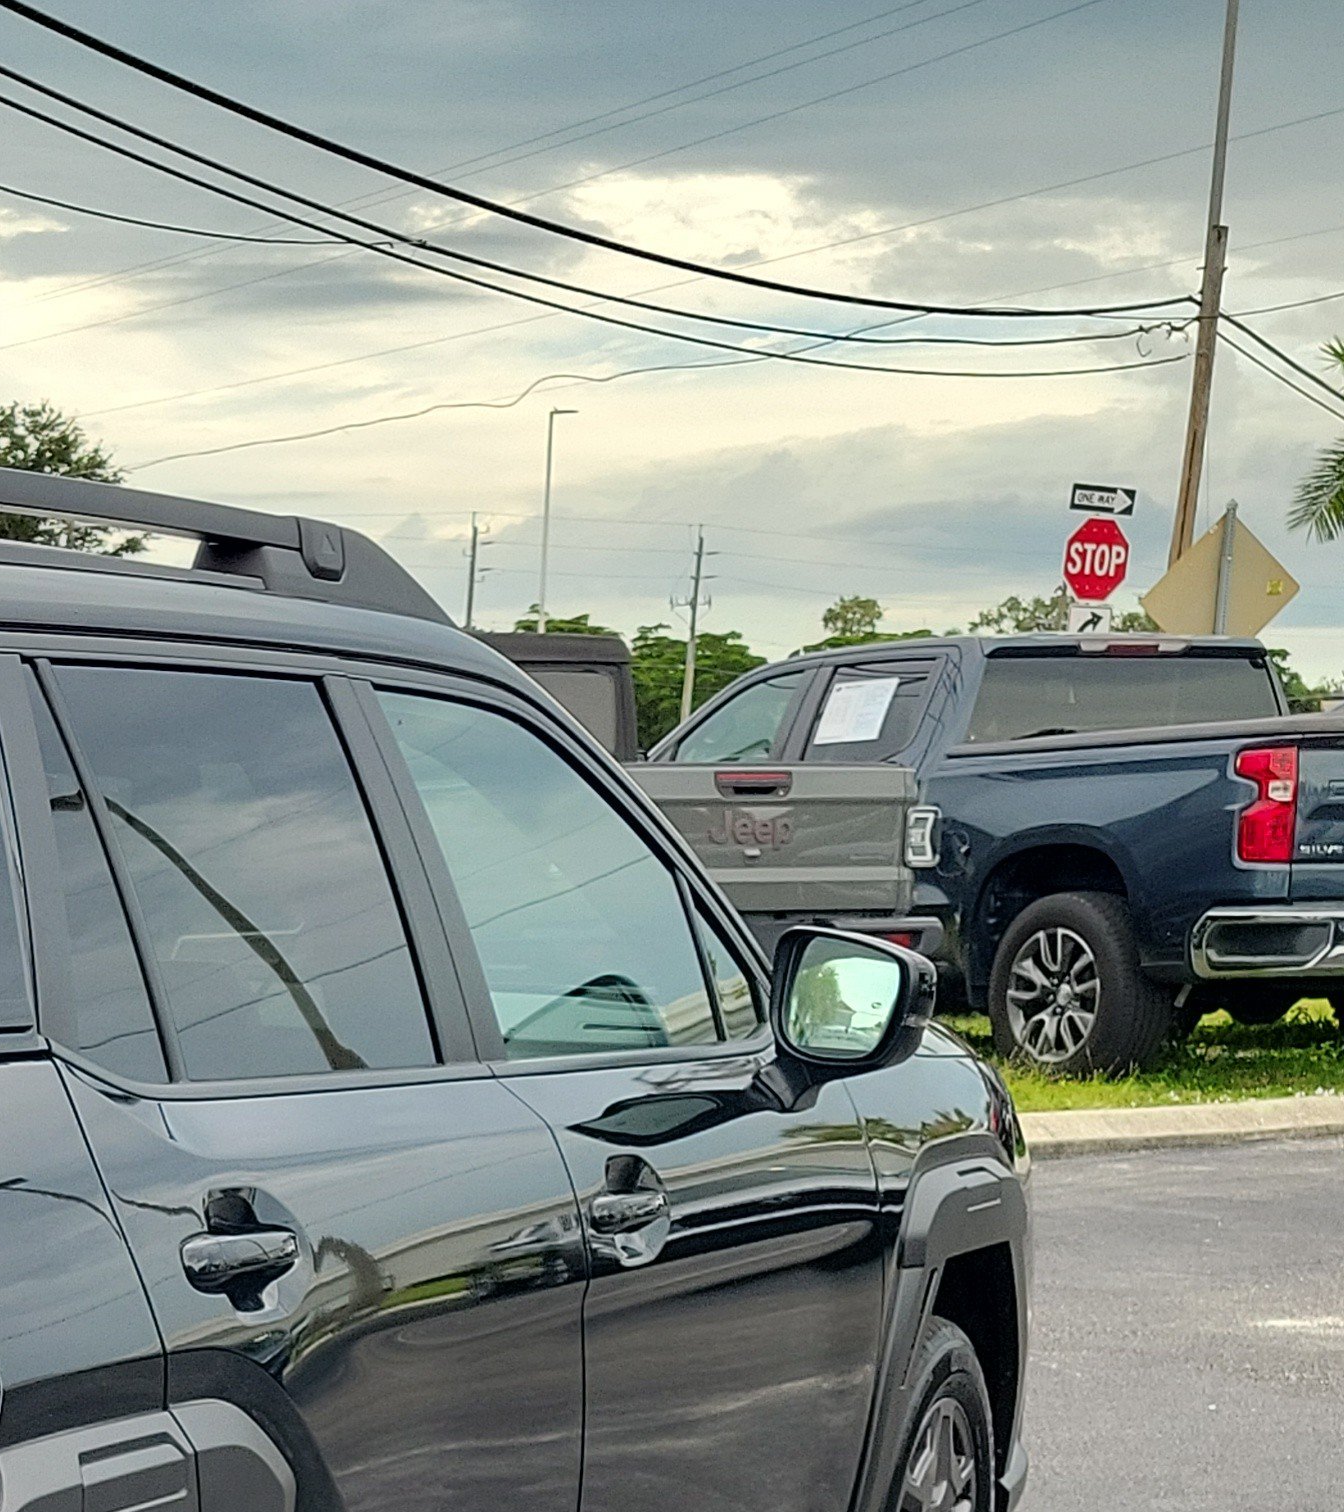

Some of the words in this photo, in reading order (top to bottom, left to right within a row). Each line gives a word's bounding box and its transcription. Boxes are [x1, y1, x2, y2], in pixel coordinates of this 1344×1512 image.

[1076, 491, 1095, 503] ONE
[1097, 494, 1116, 505] WAY
[1066, 541, 1126, 578] STOP
[707, 809, 793, 851] Jeep
